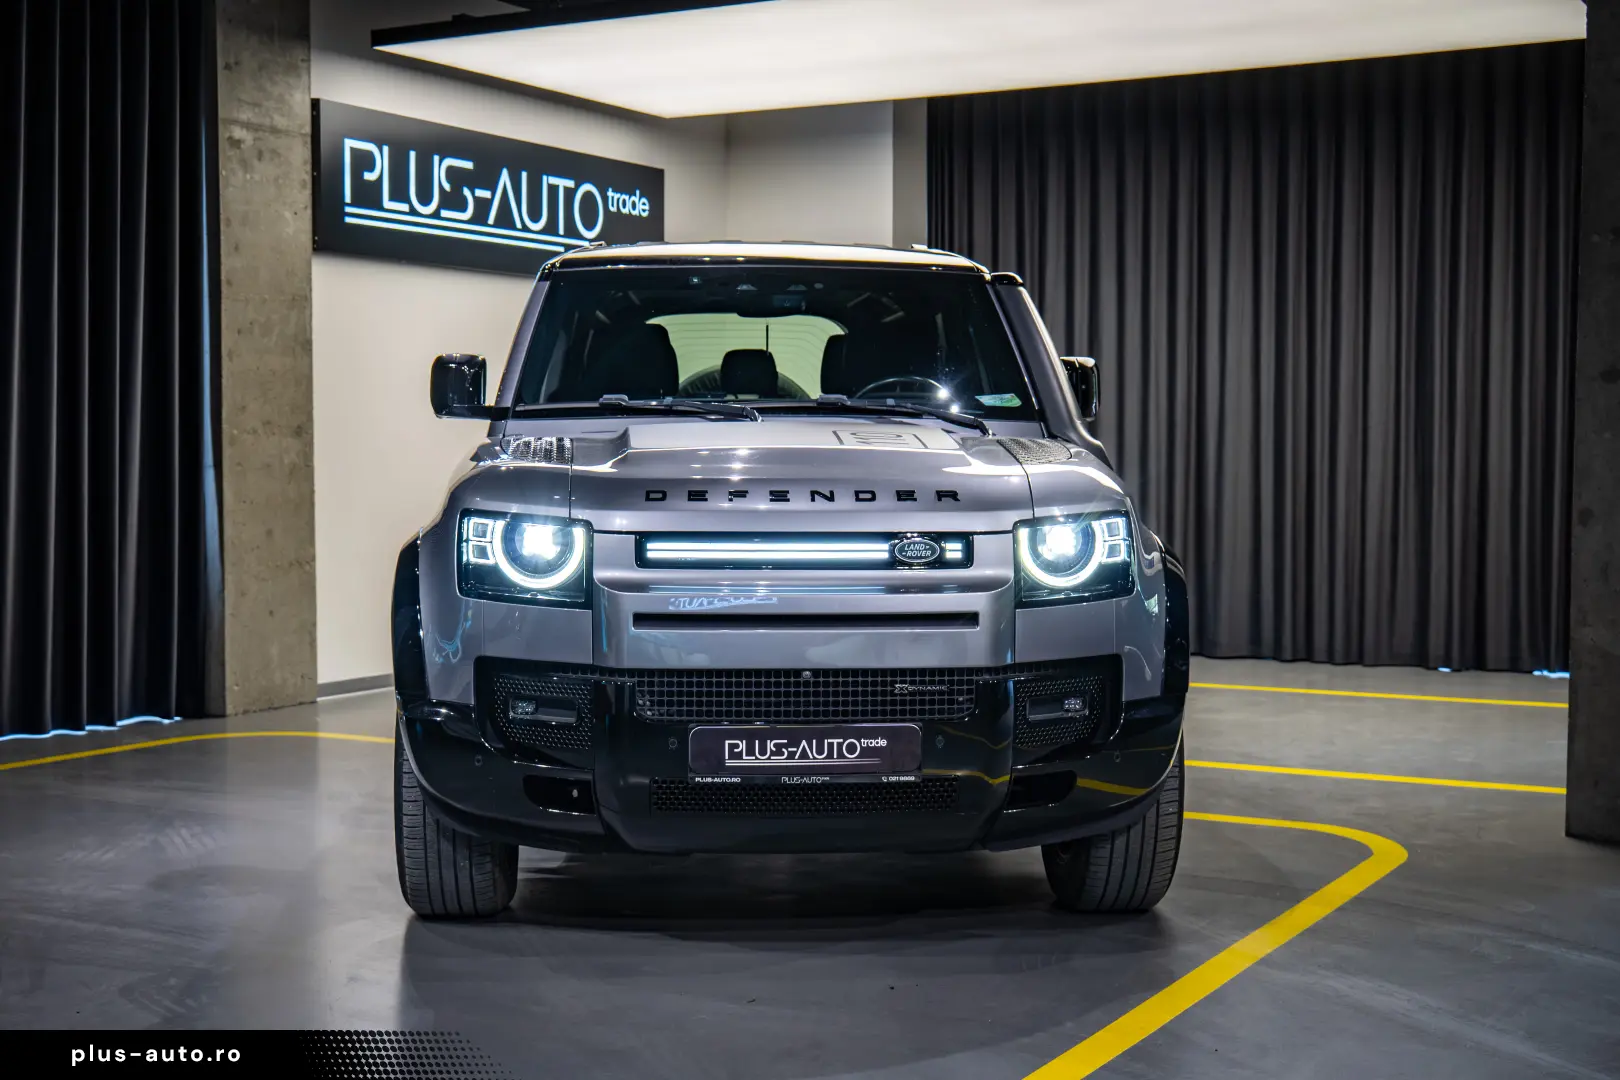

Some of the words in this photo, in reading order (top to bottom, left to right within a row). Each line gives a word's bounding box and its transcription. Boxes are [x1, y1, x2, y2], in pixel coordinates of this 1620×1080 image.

[343, 137, 604, 240] PLUS-AUTO
[606, 188, 650, 217] trade
[644, 489, 961, 503] DEFENDER
[725, 738, 861, 760] PLUS-AUTO
[860, 737, 888, 747] trade
[781, 776, 822, 784] PLUS-AUTO
